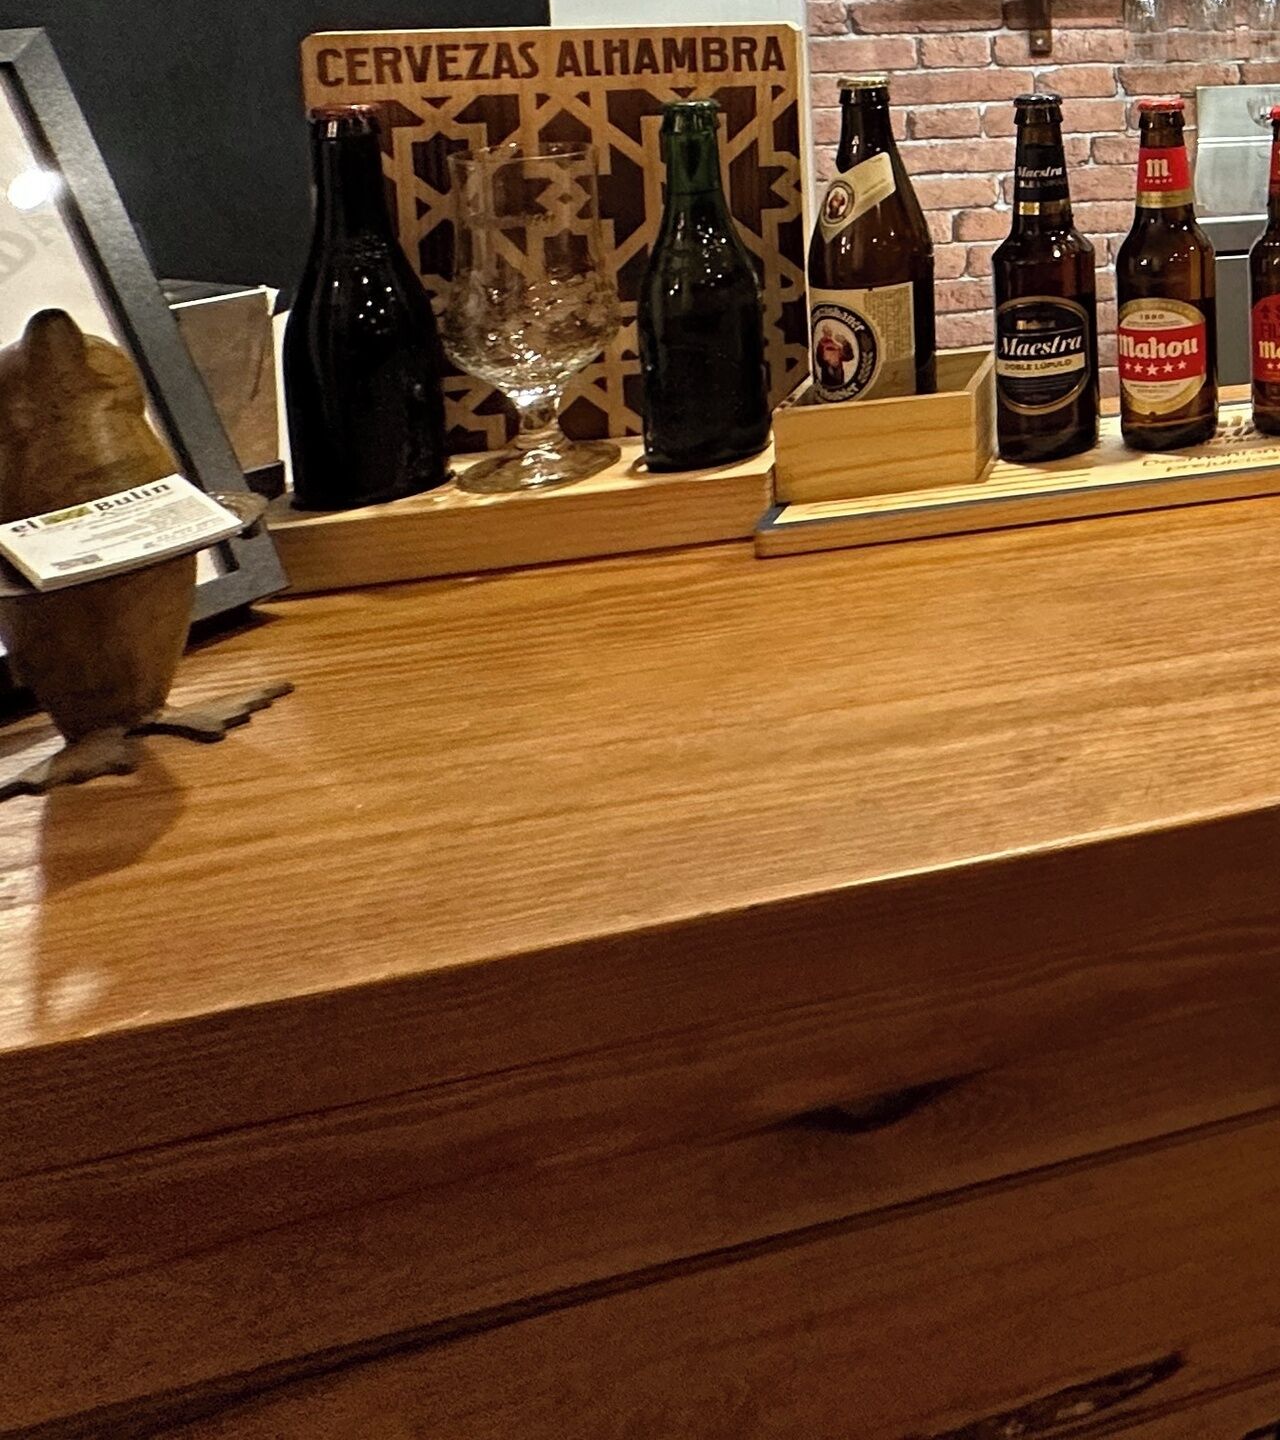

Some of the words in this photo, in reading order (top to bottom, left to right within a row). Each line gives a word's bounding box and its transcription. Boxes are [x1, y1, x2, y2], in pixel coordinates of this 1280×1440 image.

[316, 41, 539, 88] CERVEZAS
[555, 35, 786, 80] ALHAMBRA
[1000, 335, 1082, 357] Maestra
[1119, 335, 1199, 359] Mahou
[10, 520, 38, 533] el
